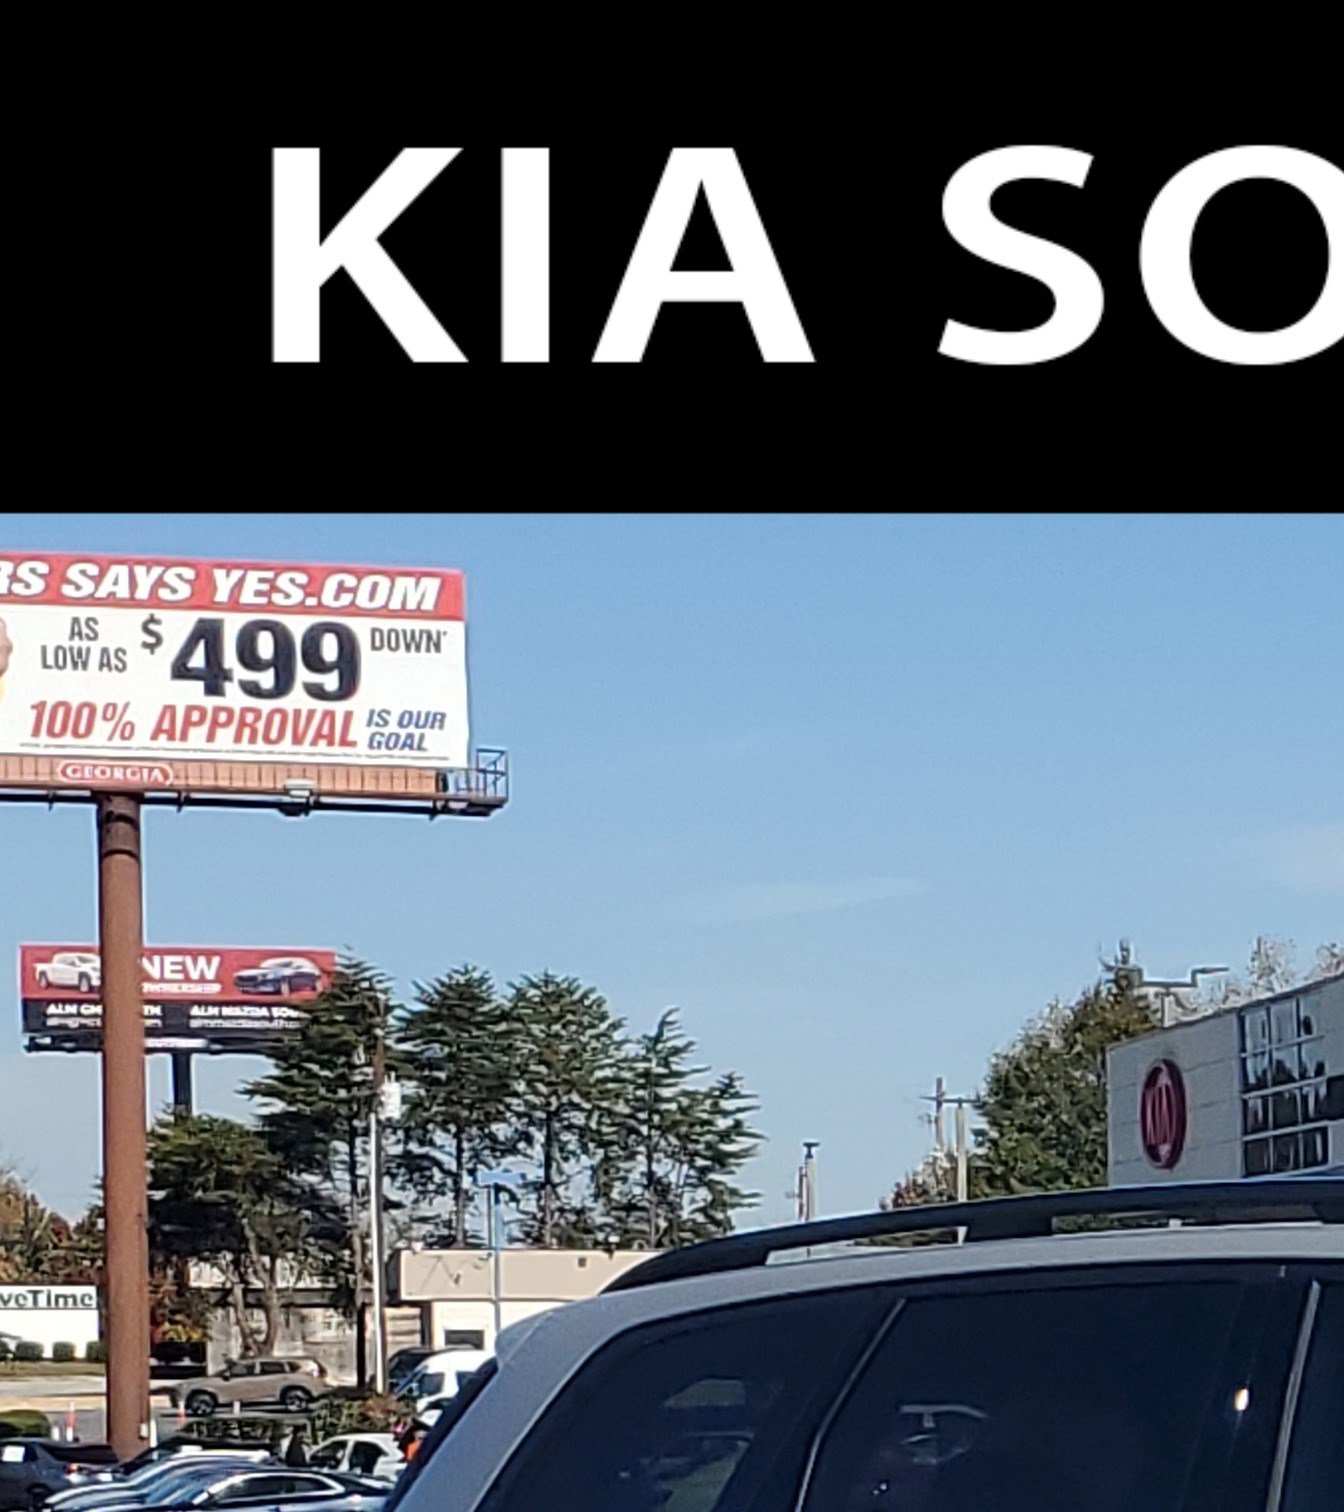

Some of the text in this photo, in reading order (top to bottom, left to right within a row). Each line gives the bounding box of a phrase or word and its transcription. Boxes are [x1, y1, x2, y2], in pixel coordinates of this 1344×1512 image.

[61, 562, 197, 602] SAYS
[212, 568, 442, 612] YES.COM
[69, 616, 100, 642] AS
[41, 644, 128, 674] LOW AS
[30, 700, 358, 748] 100% APPROVAL
[366, 708, 448, 731] IS OUR
[367, 731, 429, 752] GOAL
[66, 764, 166, 783] GEORGIA
[142, 954, 222, 981] NEW
